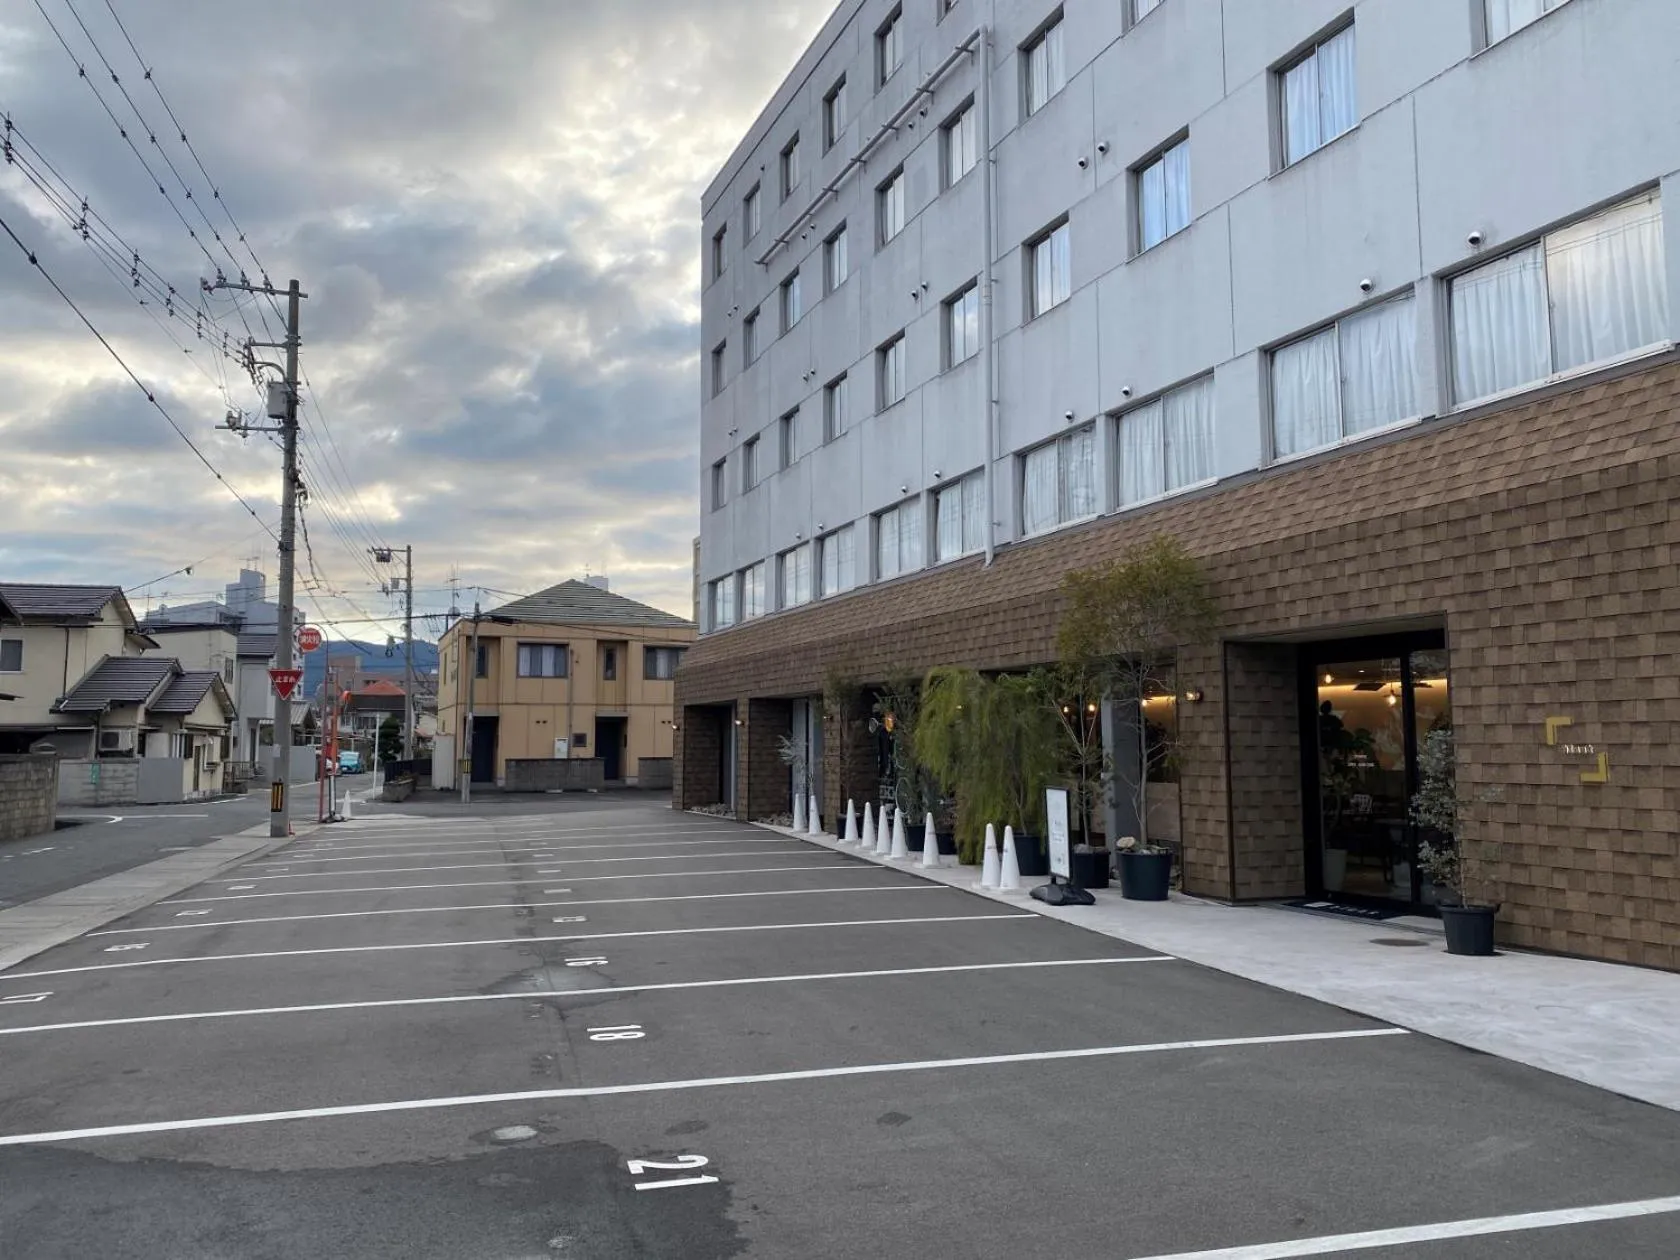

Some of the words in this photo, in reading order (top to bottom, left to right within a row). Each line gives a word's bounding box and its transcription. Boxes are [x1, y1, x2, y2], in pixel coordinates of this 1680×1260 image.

[565, 956, 609, 967] 16
[587, 1024, 646, 1041] 18
[627, 1154, 720, 1191] 21
